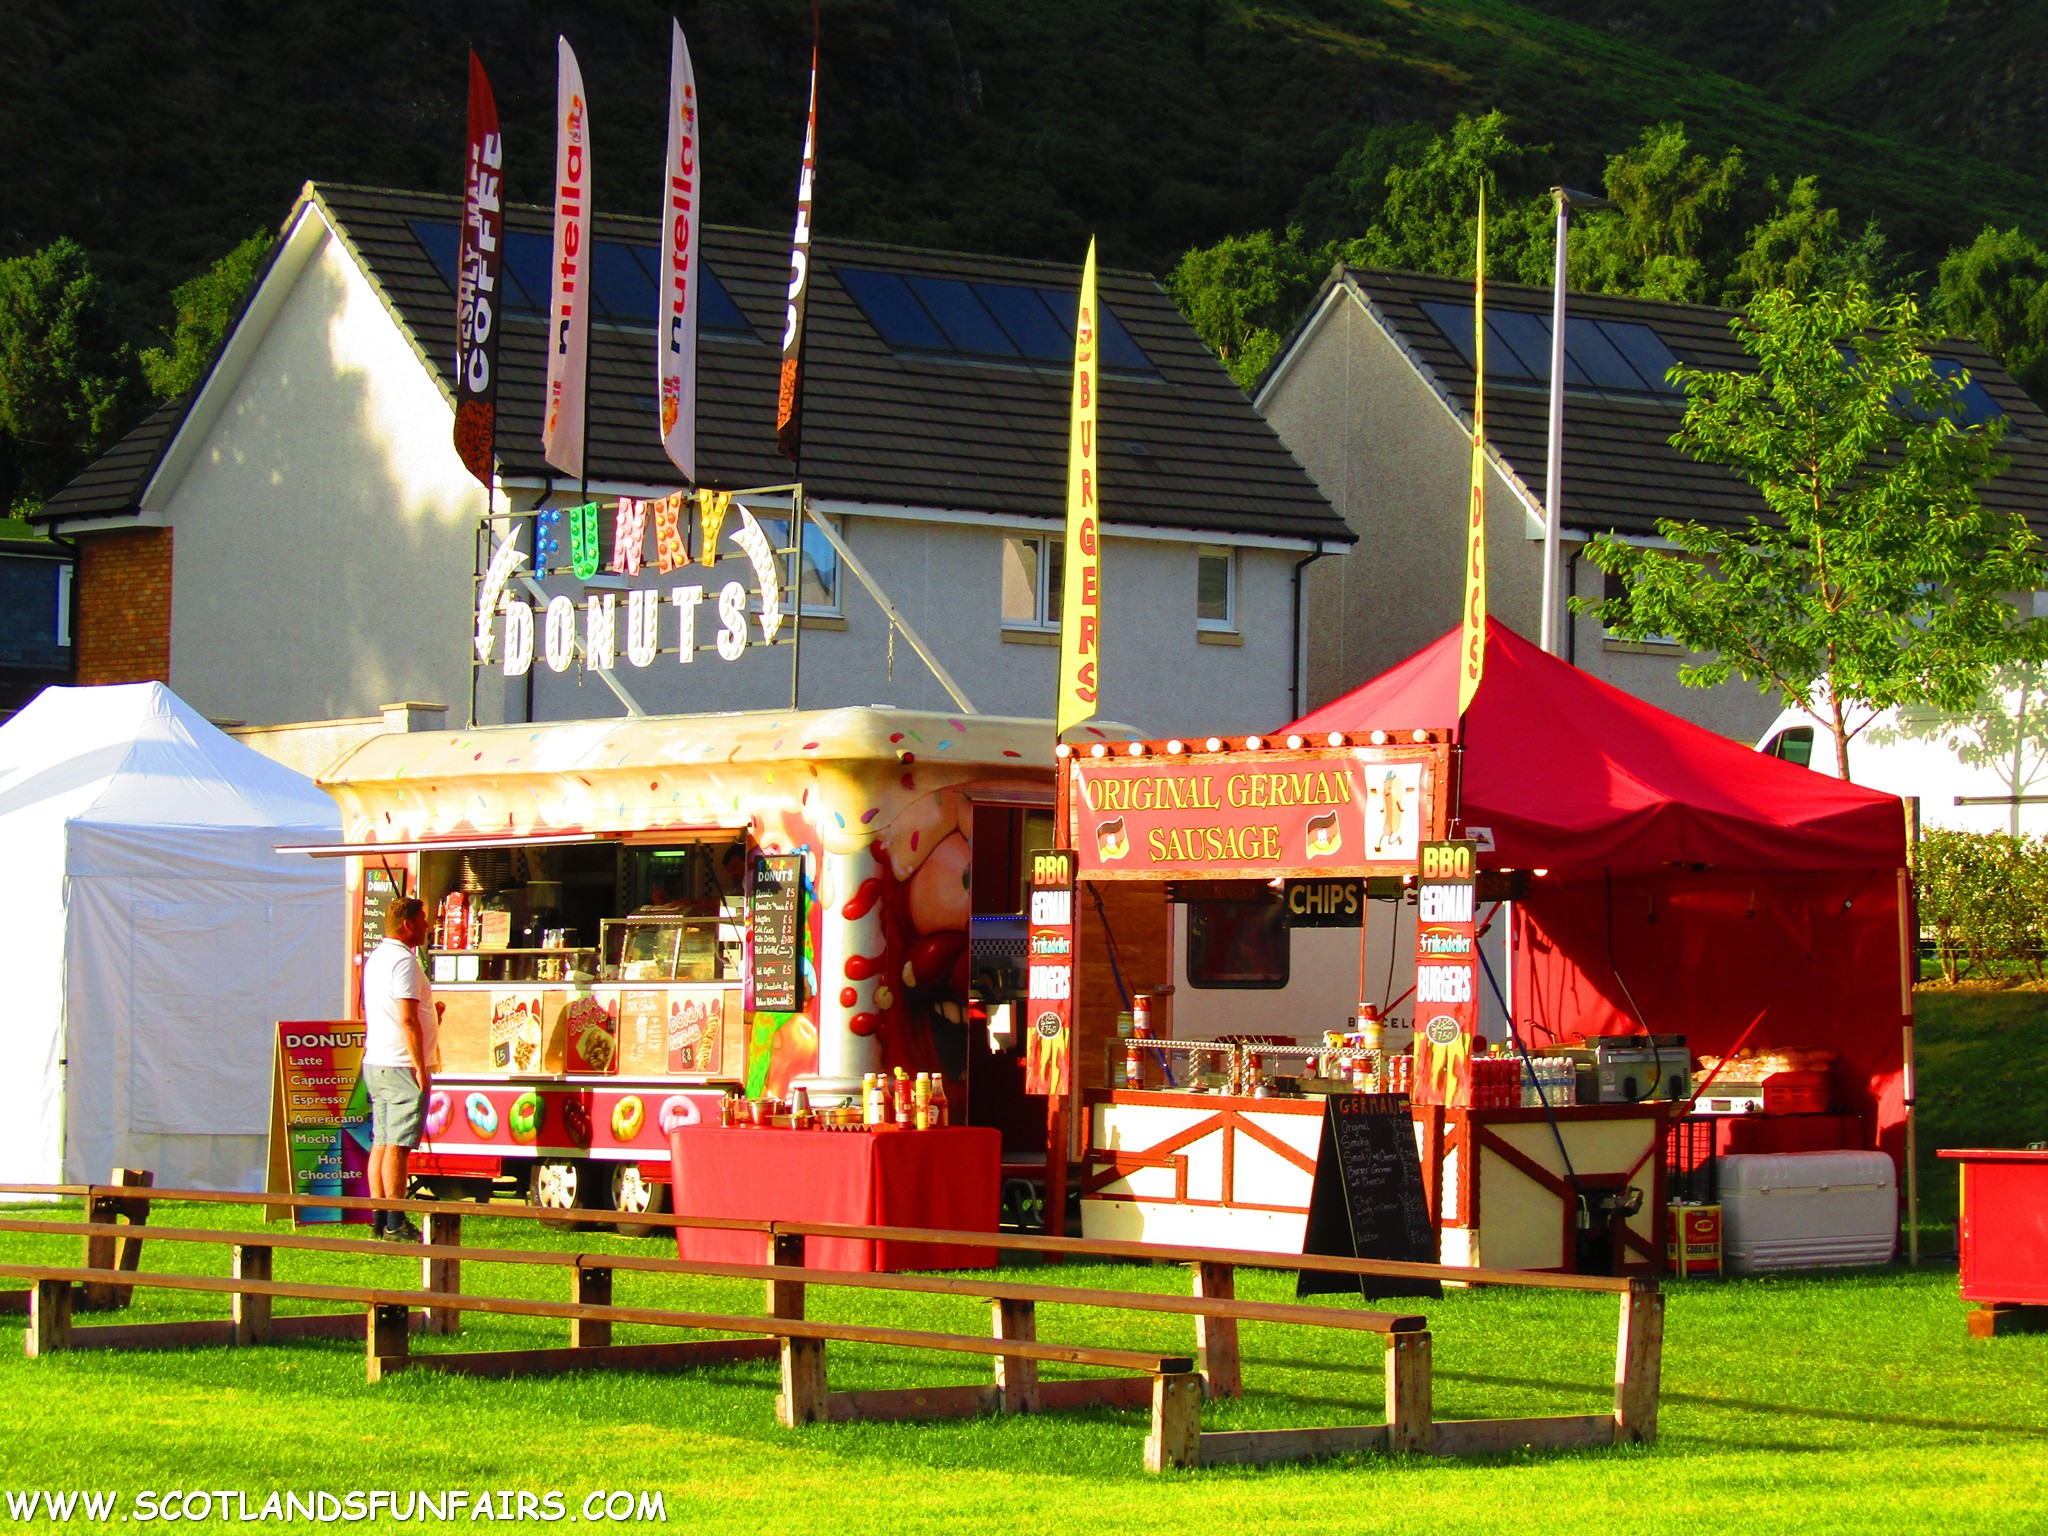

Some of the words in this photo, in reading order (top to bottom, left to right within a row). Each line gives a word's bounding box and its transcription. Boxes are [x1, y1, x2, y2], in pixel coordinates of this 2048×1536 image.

[559, 145, 583, 355] nutella
[670, 135, 693, 355] nutella
[468, 132, 503, 393] COFFEE
[535, 487, 733, 580] FUNKY
[1077, 369, 1098, 703] BURGERS
[503, 581, 749, 676] DONUTS
[1086, 775, 1221, 812] ORIGINAL
[1227, 770, 1354, 808] GERMAN
[1148, 825, 1282, 862] SAUSAGE
[758, 870, 793, 882] DONUTS
[1034, 855, 1069, 886] BBQ
[1423, 846, 1471, 880] BBQ
[1289, 883, 1358, 915] CHIPS
[1419, 885, 1473, 923] GERMAN
[1029, 965, 1071, 1000] BURGERS
[1417, 965, 1471, 1003] BURGERS
[669, 1001, 705, 1033] DONUT
[286, 1032, 366, 1049] DONUT
[289, 1055, 323, 1066] Latte
[290, 1075, 357, 1088] Capuccino
[292, 1094, 347, 1107] Espresso
[1339, 1098, 1399, 1115] GERMAN
[293, 1114, 364, 1124] Americano
[295, 1133, 337, 1144] Mocha
[298, 1169, 363, 1180] Chocolate
[318, 1154, 343, 1165] Hot
